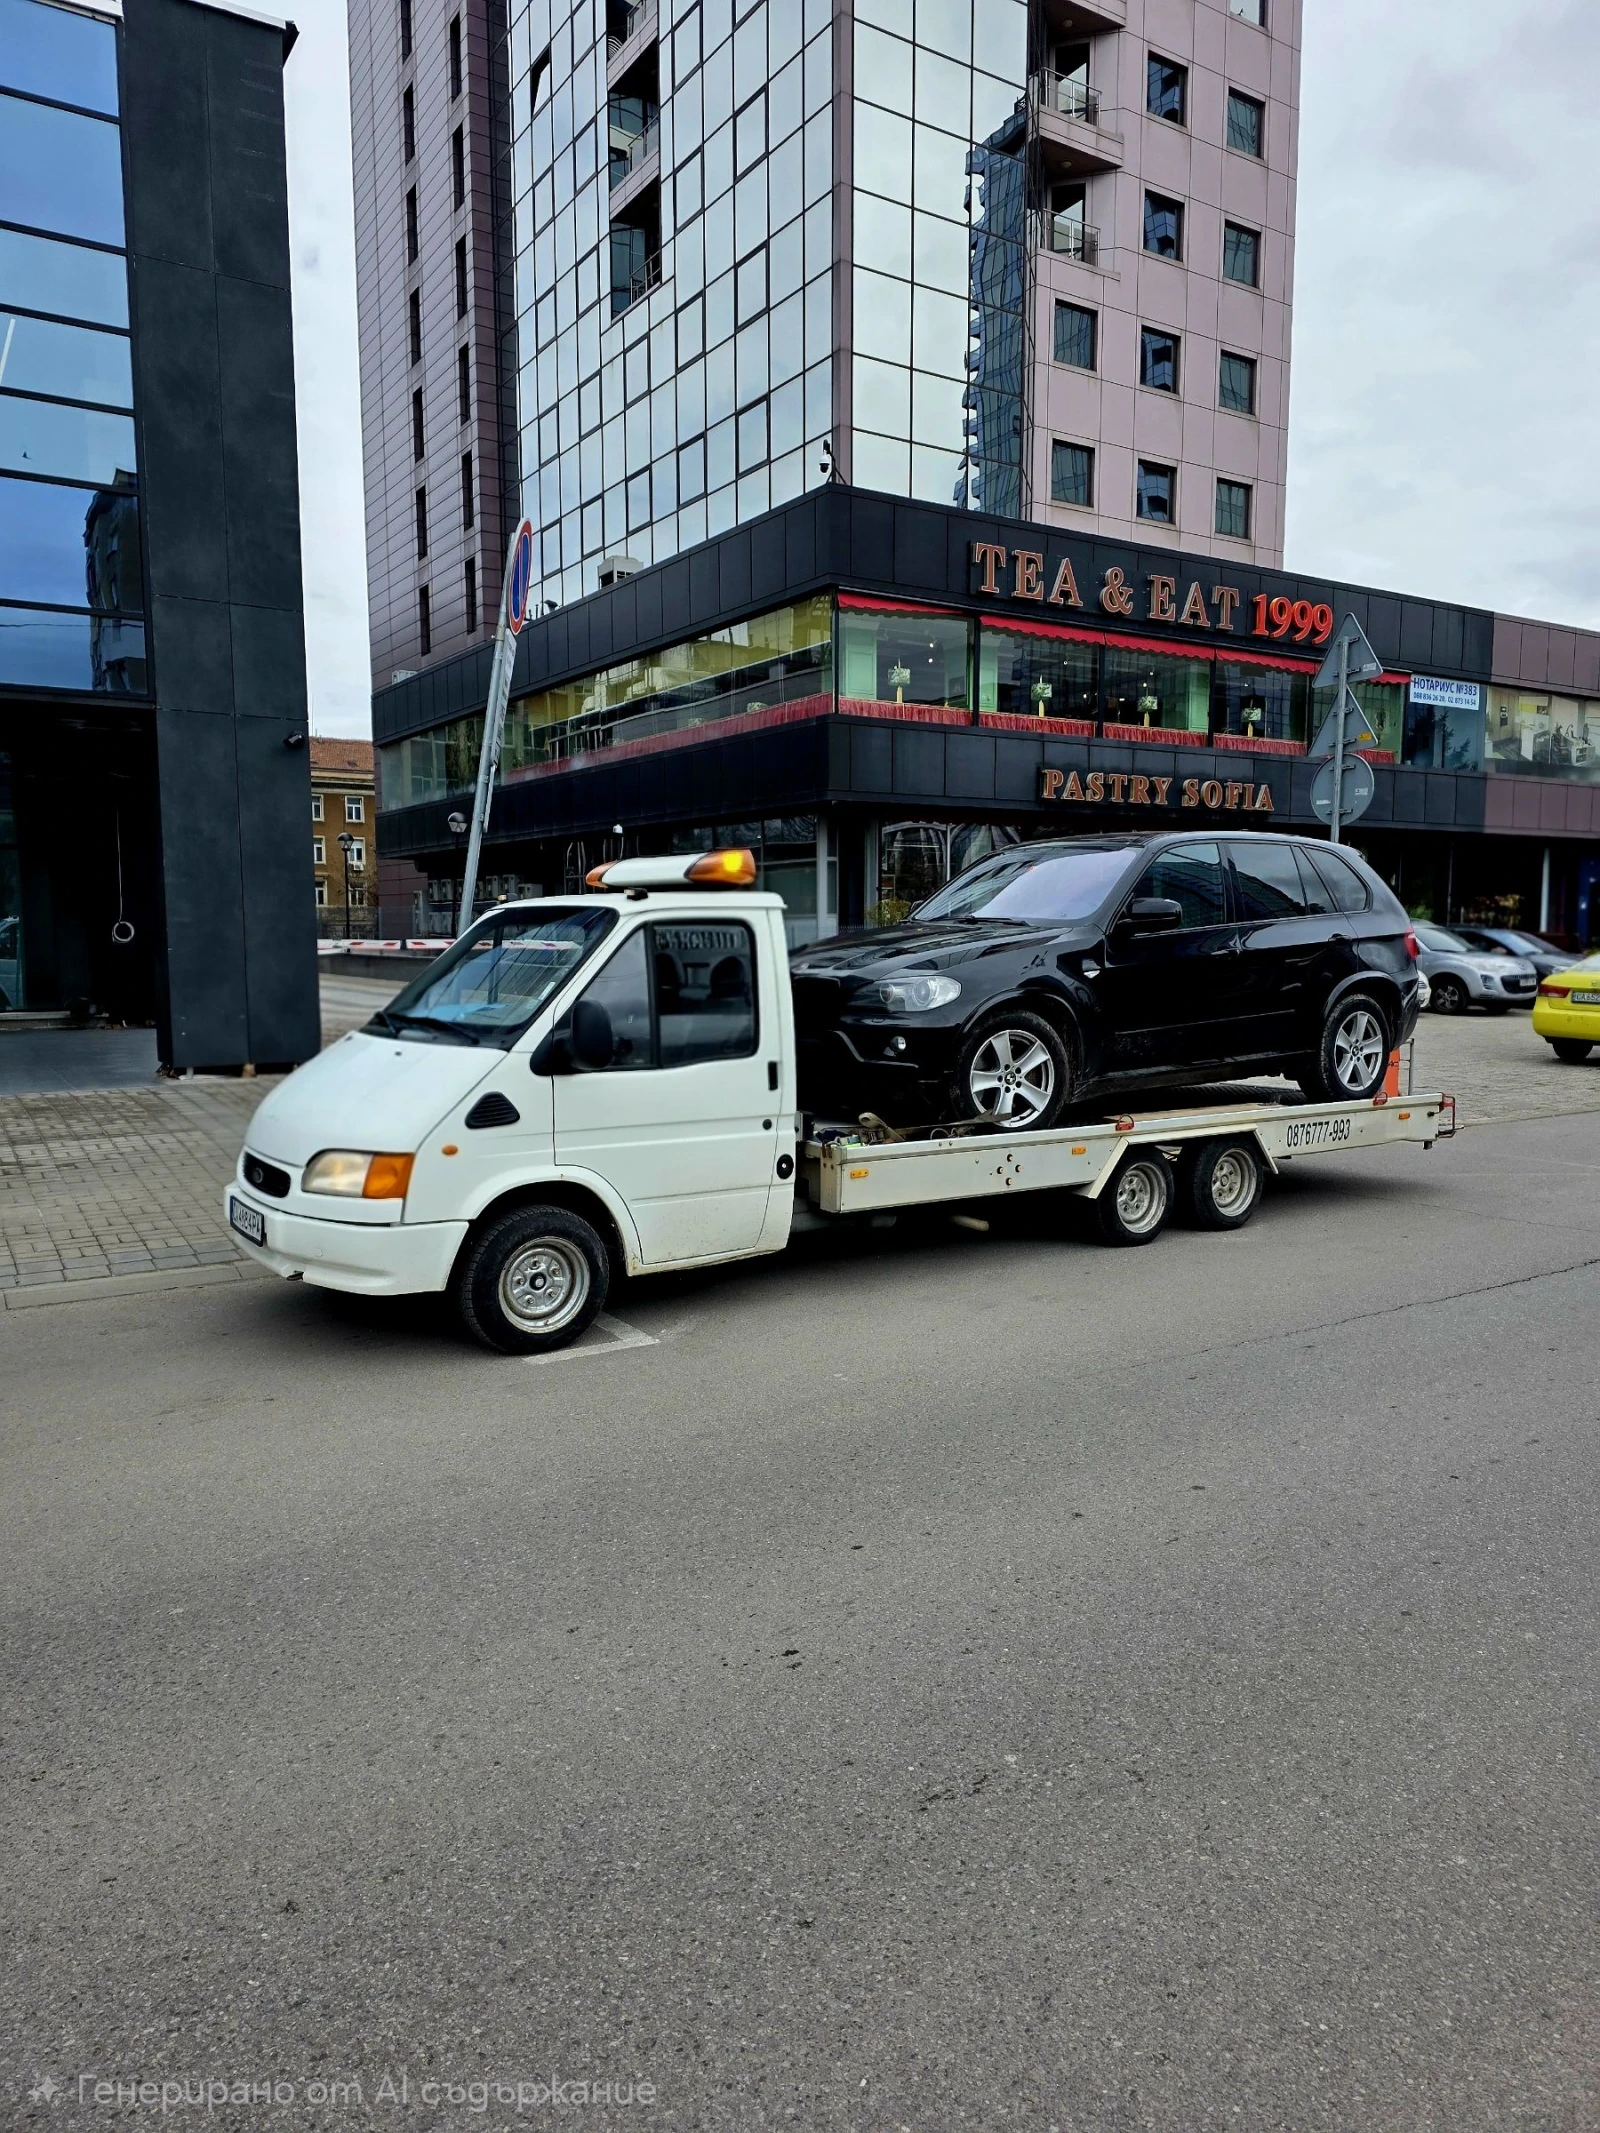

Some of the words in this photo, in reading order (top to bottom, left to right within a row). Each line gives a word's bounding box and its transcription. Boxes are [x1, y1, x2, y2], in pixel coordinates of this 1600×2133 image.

[973, 541, 1084, 607] TEA
[1100, 566, 1134, 616] &
[1147, 574, 1240, 631] EAT
[1252, 593, 1334, 645] 1999
[1413, 677, 1455, 693] НОТАРИУС
[1456, 682, 1477, 696] №383
[1042, 769, 1173, 805] PASTRY
[1182, 779, 1275, 812] SOFIA
[1286, 1118, 1351, 1148] 0876777-993
